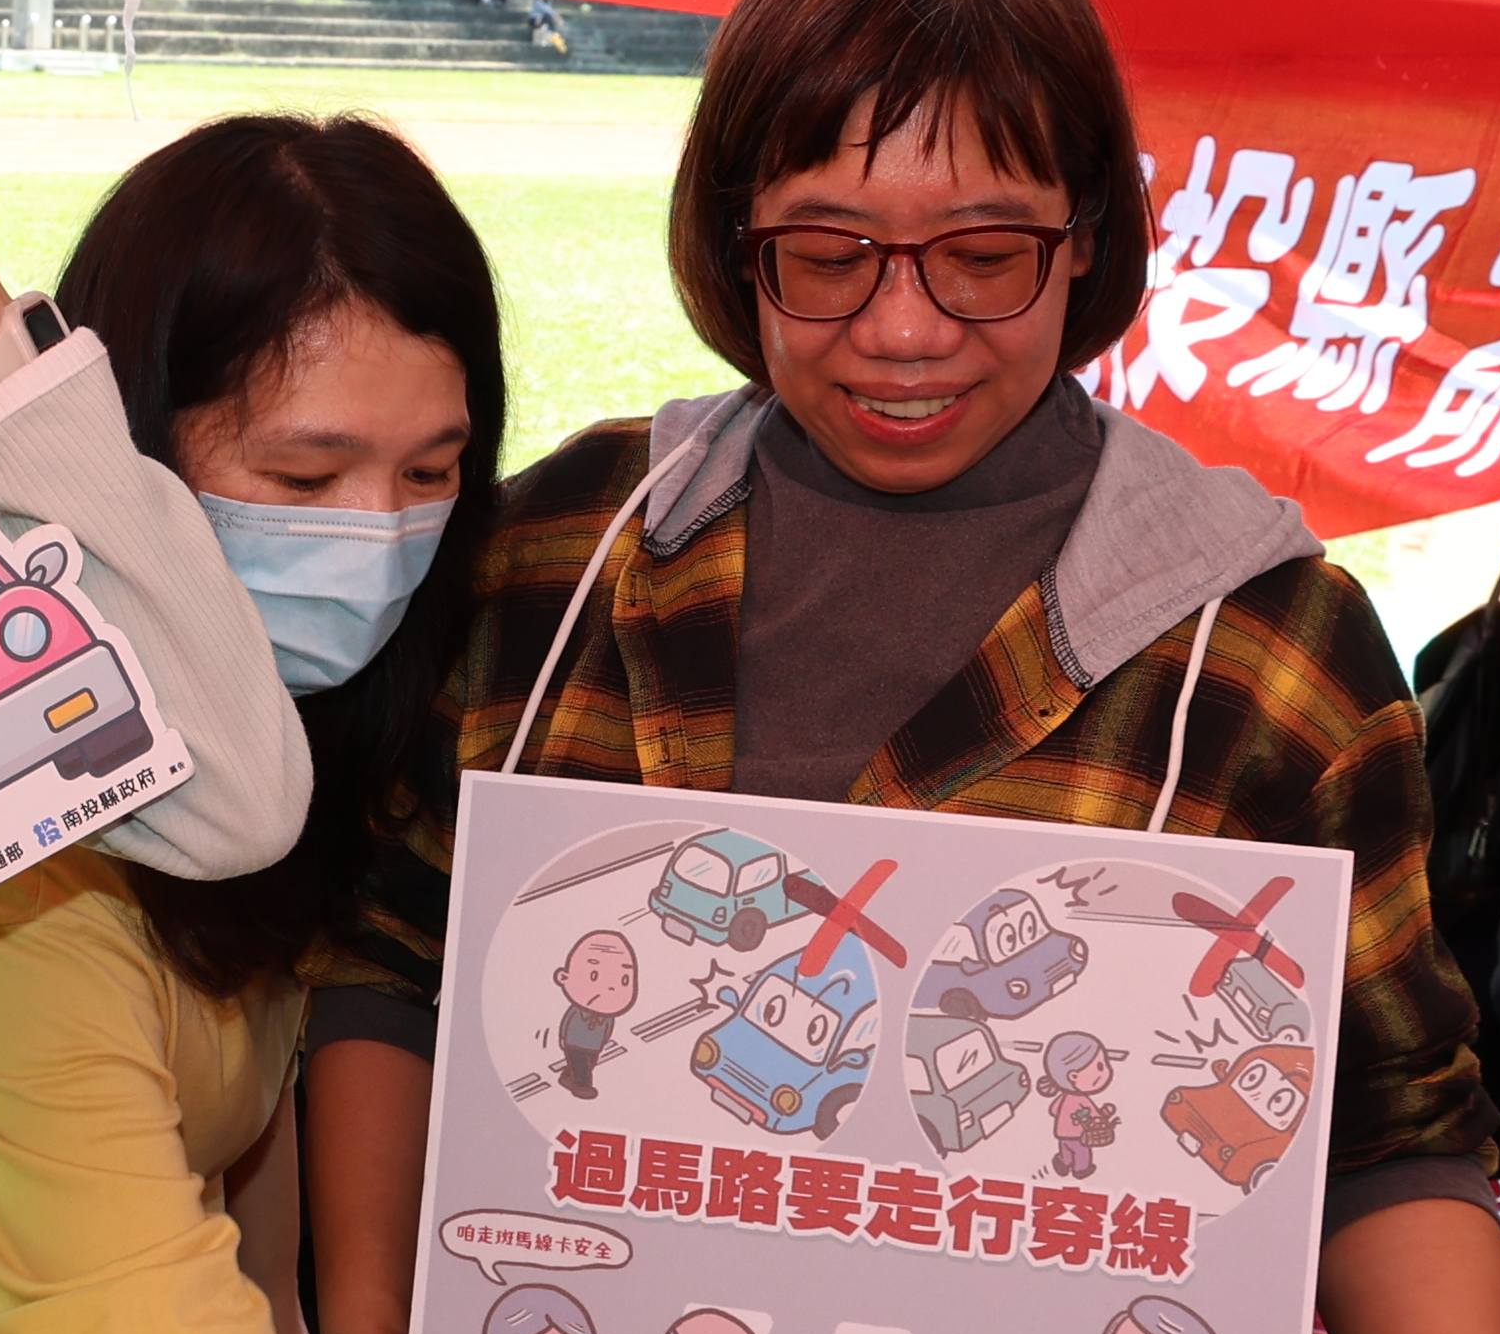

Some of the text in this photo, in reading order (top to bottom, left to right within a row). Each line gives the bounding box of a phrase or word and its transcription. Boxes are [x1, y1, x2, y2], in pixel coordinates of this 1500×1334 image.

[60, 766, 157, 831] 南投縣政府
[551, 1127, 1195, 1282] 過馬路要走行穿線
